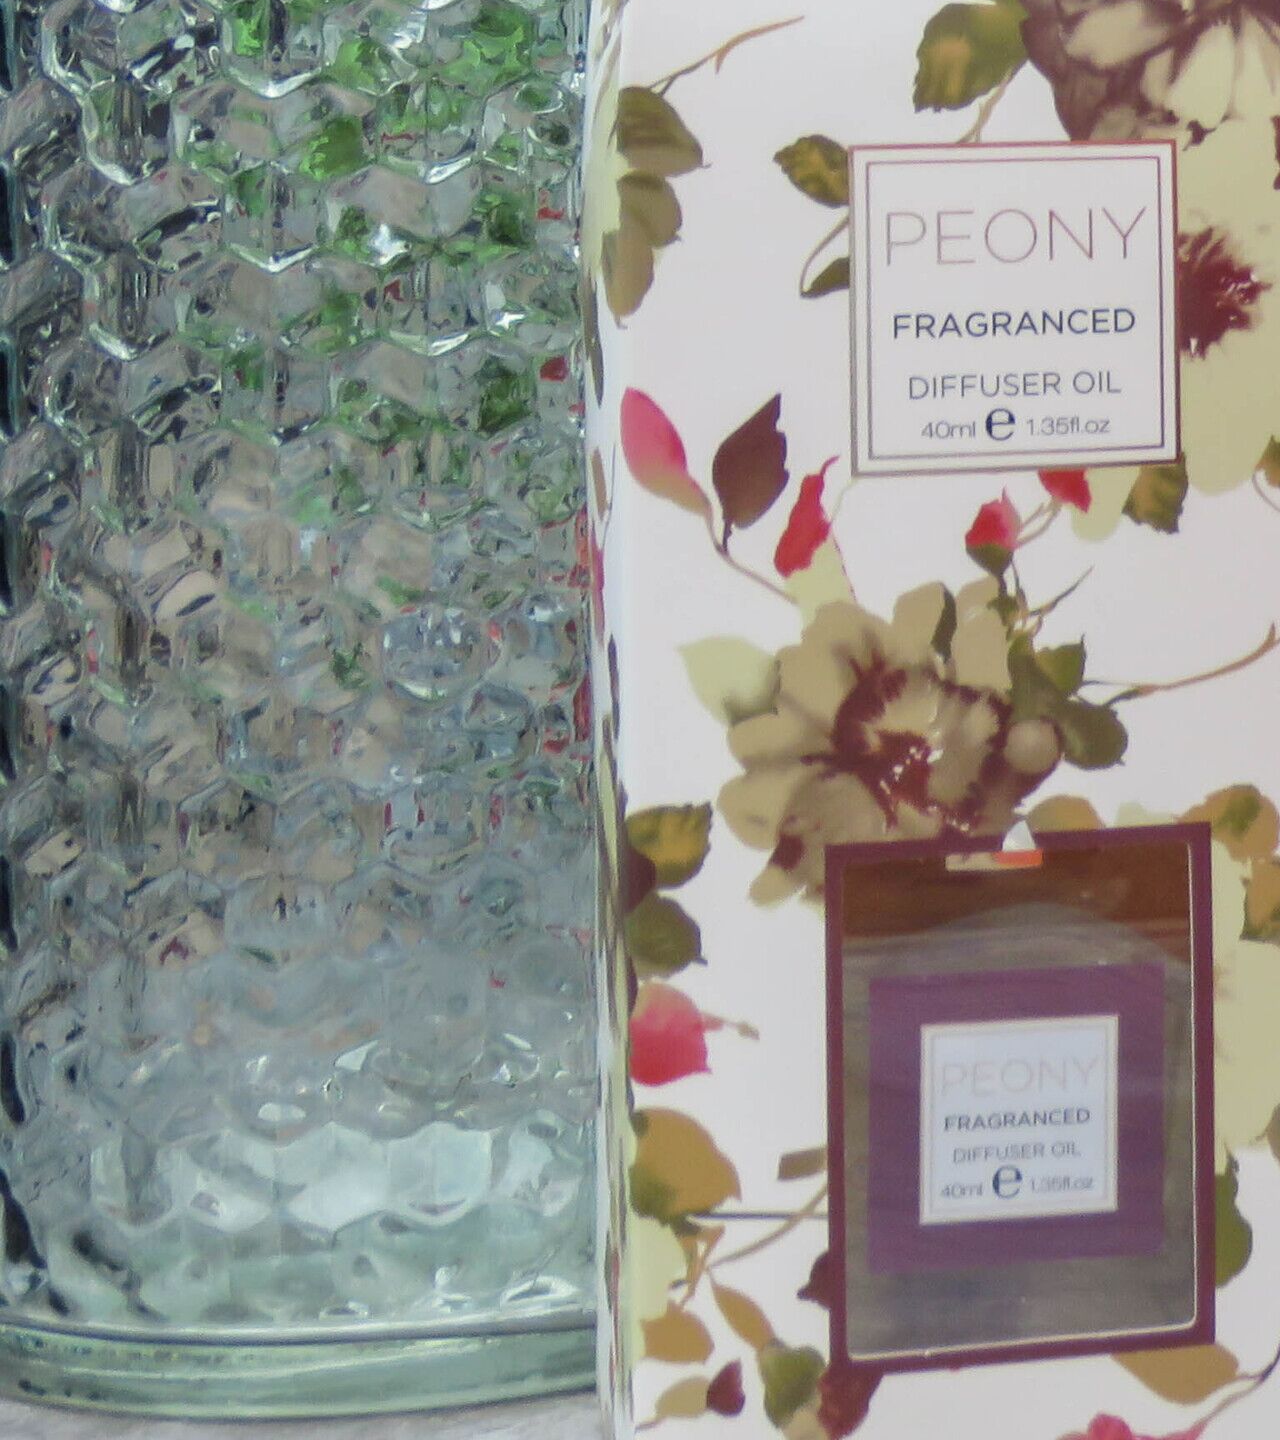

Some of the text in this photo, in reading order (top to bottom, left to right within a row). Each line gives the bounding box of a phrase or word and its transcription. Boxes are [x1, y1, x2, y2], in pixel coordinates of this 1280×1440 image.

[887, 206, 1147, 266] PEONY
[893, 308, 1136, 339] FRAGRANCED
[909, 370, 1122, 400] DIFFUSER OIL
[921, 419, 976, 440] 40ml
[940, 1057, 1098, 1097] PEONY
[944, 1108, 1091, 1132] FRAGRANCED
[953, 1141, 1082, 1164] DIFFUSER OIL
[940, 1182, 983, 1199] 40ml
